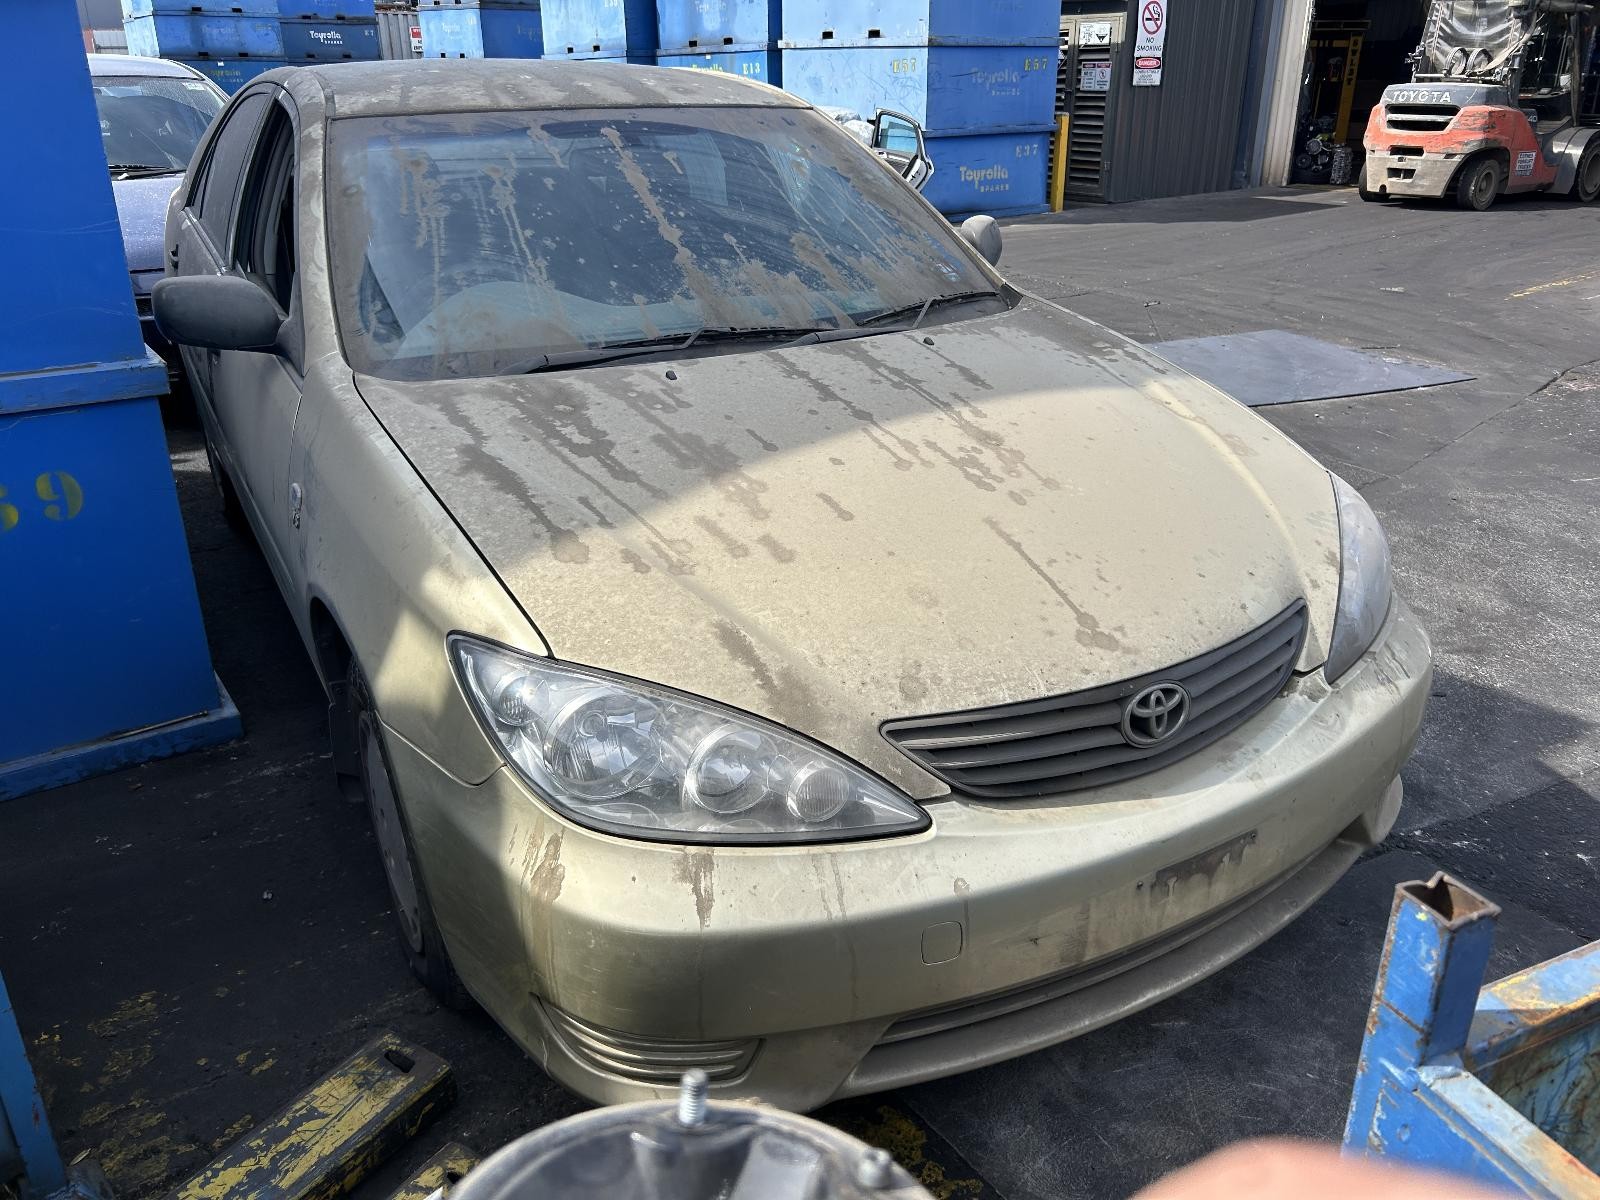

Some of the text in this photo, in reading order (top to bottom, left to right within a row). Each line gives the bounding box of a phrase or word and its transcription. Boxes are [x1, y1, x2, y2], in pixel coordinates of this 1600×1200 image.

[742, 62, 760, 75] E13
[892, 58, 917, 74] E57
[1024, 57, 1048, 72] E57
[1392, 90, 1452, 103] TOYOTA
[960, 164, 1009, 190] Toyrolla
